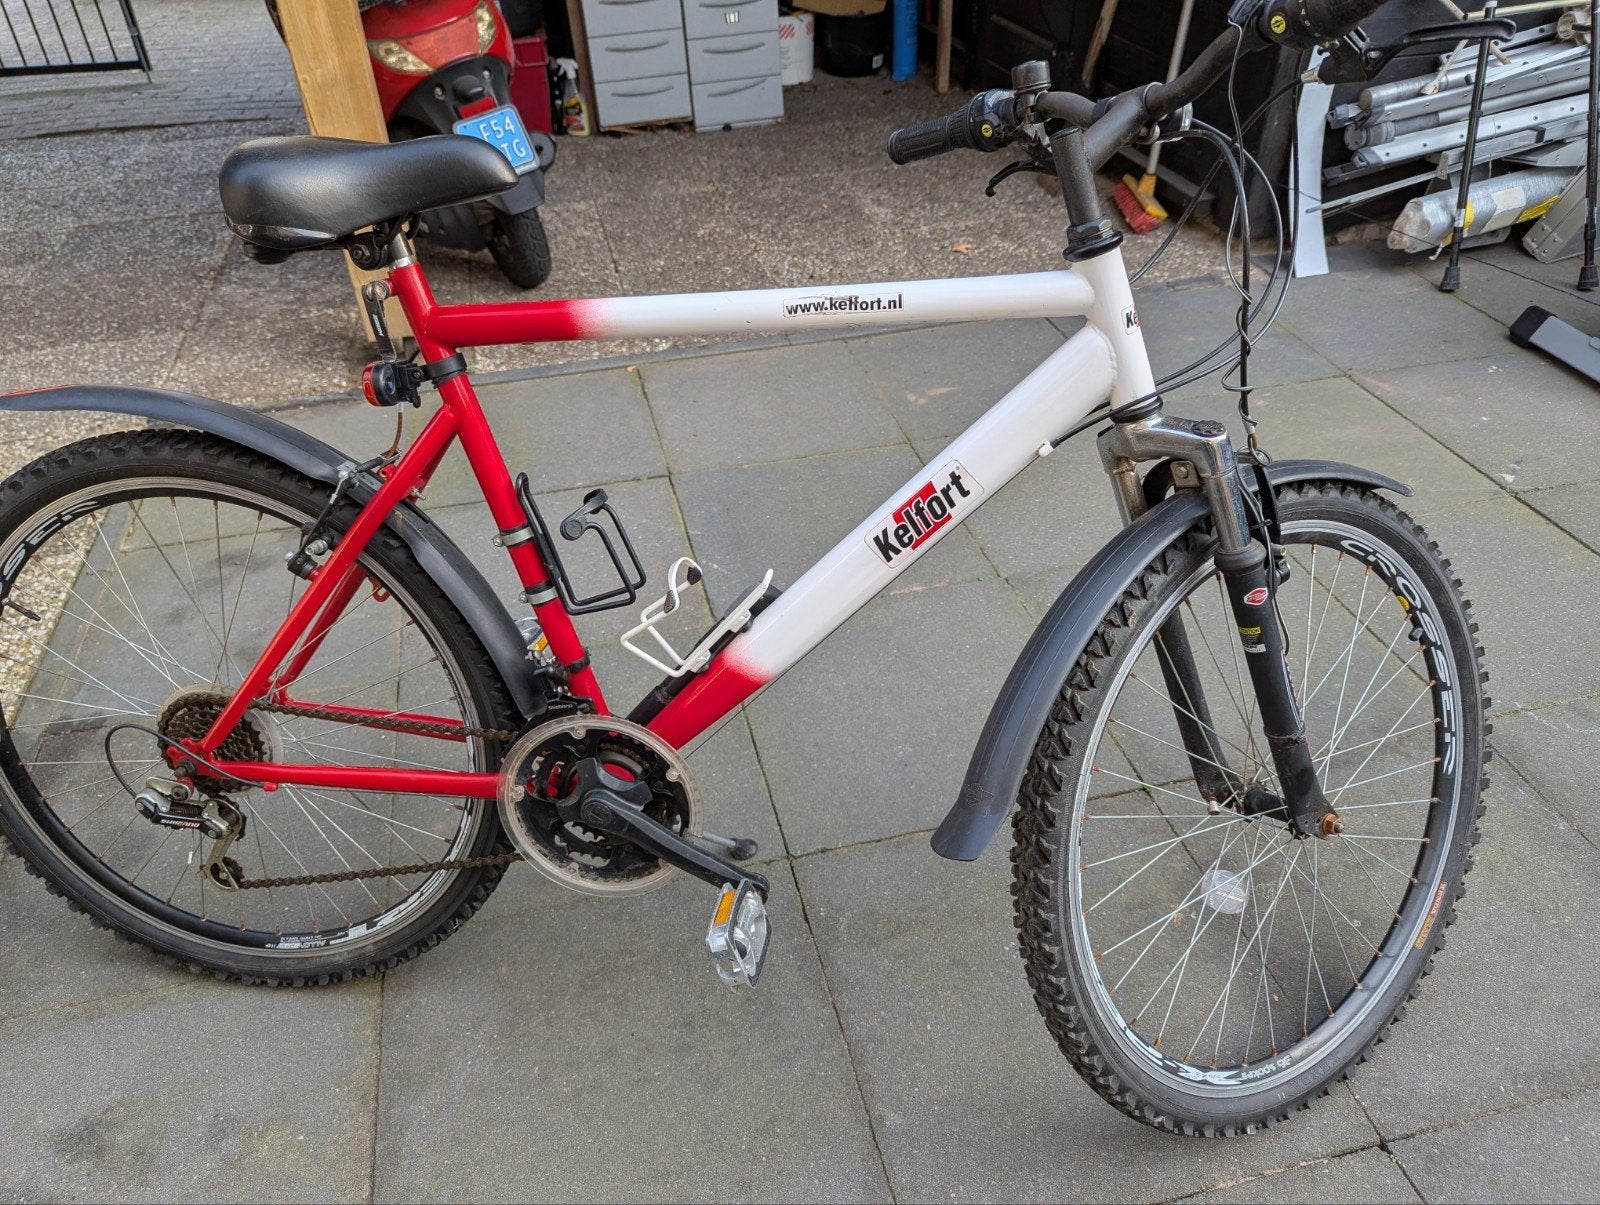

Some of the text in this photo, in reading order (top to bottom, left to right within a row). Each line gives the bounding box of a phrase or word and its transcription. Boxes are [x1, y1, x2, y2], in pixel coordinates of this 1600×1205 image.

[785, 293, 903, 315] www.kelfort.nl
[872, 470, 971, 563] Kelfort
[1340, 539, 1456, 776] CROSSER
